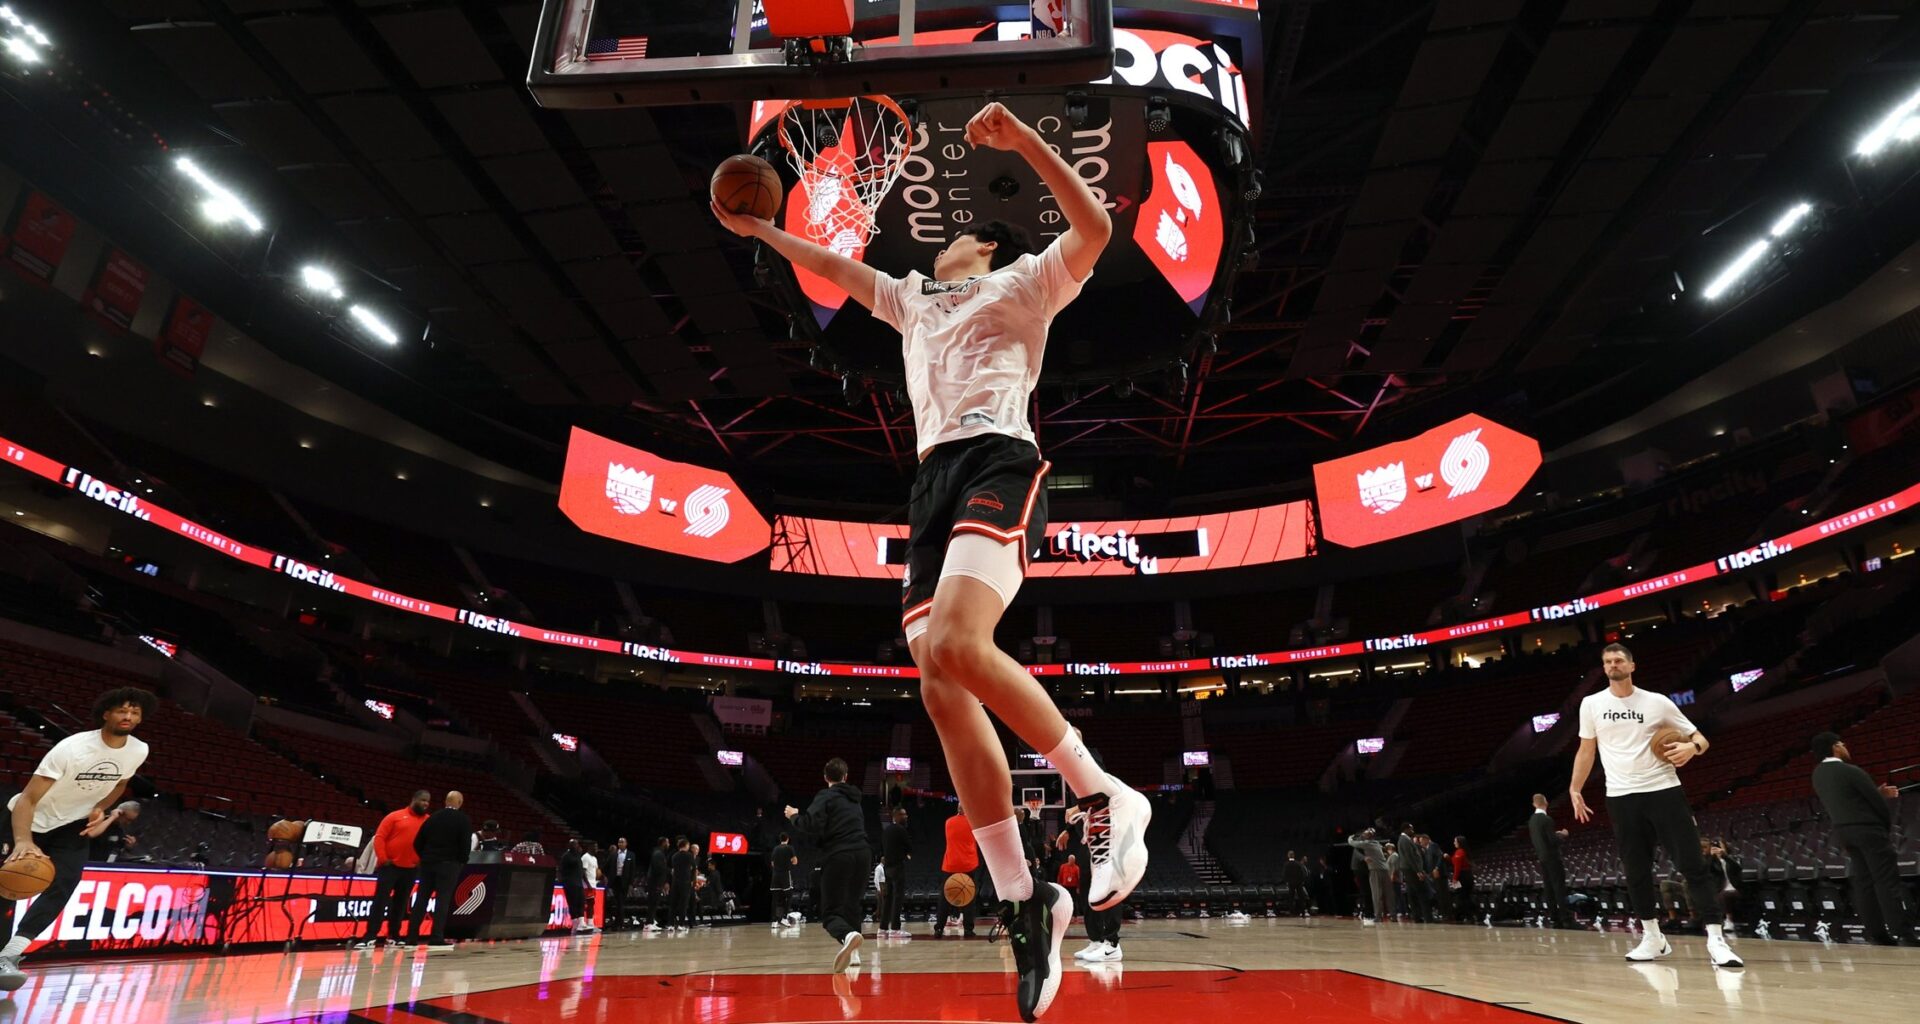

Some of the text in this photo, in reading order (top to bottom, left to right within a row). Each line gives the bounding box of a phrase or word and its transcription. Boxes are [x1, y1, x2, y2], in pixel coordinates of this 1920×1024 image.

[938, 121, 974, 238] enter
[7, 446, 25, 461] TO
[1819, 500, 1896, 534] WELCOME TO
[180, 522, 242, 555] WELCOME TO
[1623, 573, 1687, 597] WELCOME TO
[371, 589, 431, 613] WELCOME TO
[1449, 619, 1504, 636] WELCOME TO
[543, 632, 598, 647] WELCOME TO
[703, 656, 753, 667] WELCOME TO
[1290, 649, 1327, 659] WELCOME
[852, 667, 887, 675] WELCOME
[1141, 663, 1176, 671] WELCOME
[1603, 709, 1644, 724] ripcity
